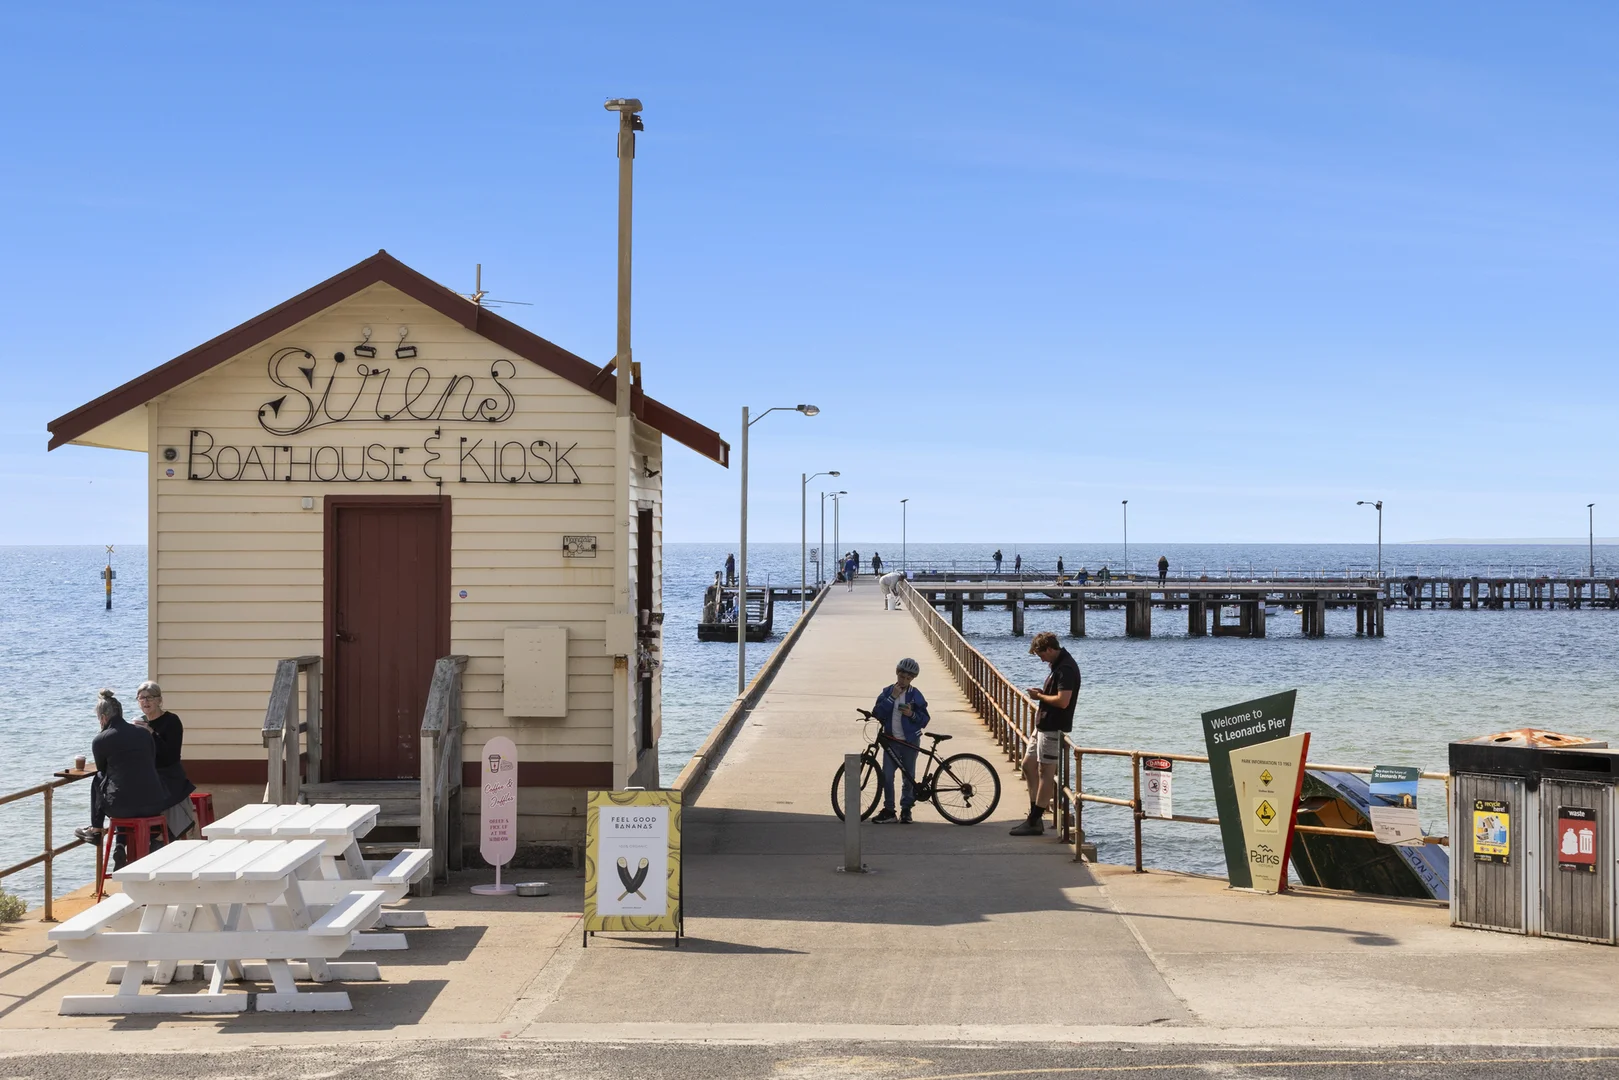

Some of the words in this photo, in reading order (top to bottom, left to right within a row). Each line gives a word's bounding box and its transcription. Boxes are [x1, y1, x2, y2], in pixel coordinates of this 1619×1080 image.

[257, 346, 516, 436] Sirens
[188, 429, 412, 482] BOATHOUSE
[423, 426, 442, 482] &
[459, 436, 581, 484] KIOSK
[1210, 713, 1251, 730] Welcome
[1252, 709, 1263, 720] to
[1213, 732, 1224, 744] St
[1224, 722, 1267, 742] Leonards
[1267, 717, 1287, 731] Pier
[484, 783, 504, 795] Coffee
[506, 778, 513, 788] &
[490, 793, 514, 808] Jaffles
[1567, 810, 1586, 818] waste
[1250, 849, 1280, 865] Parks
[1401, 846, 1439, 892] TENDE
